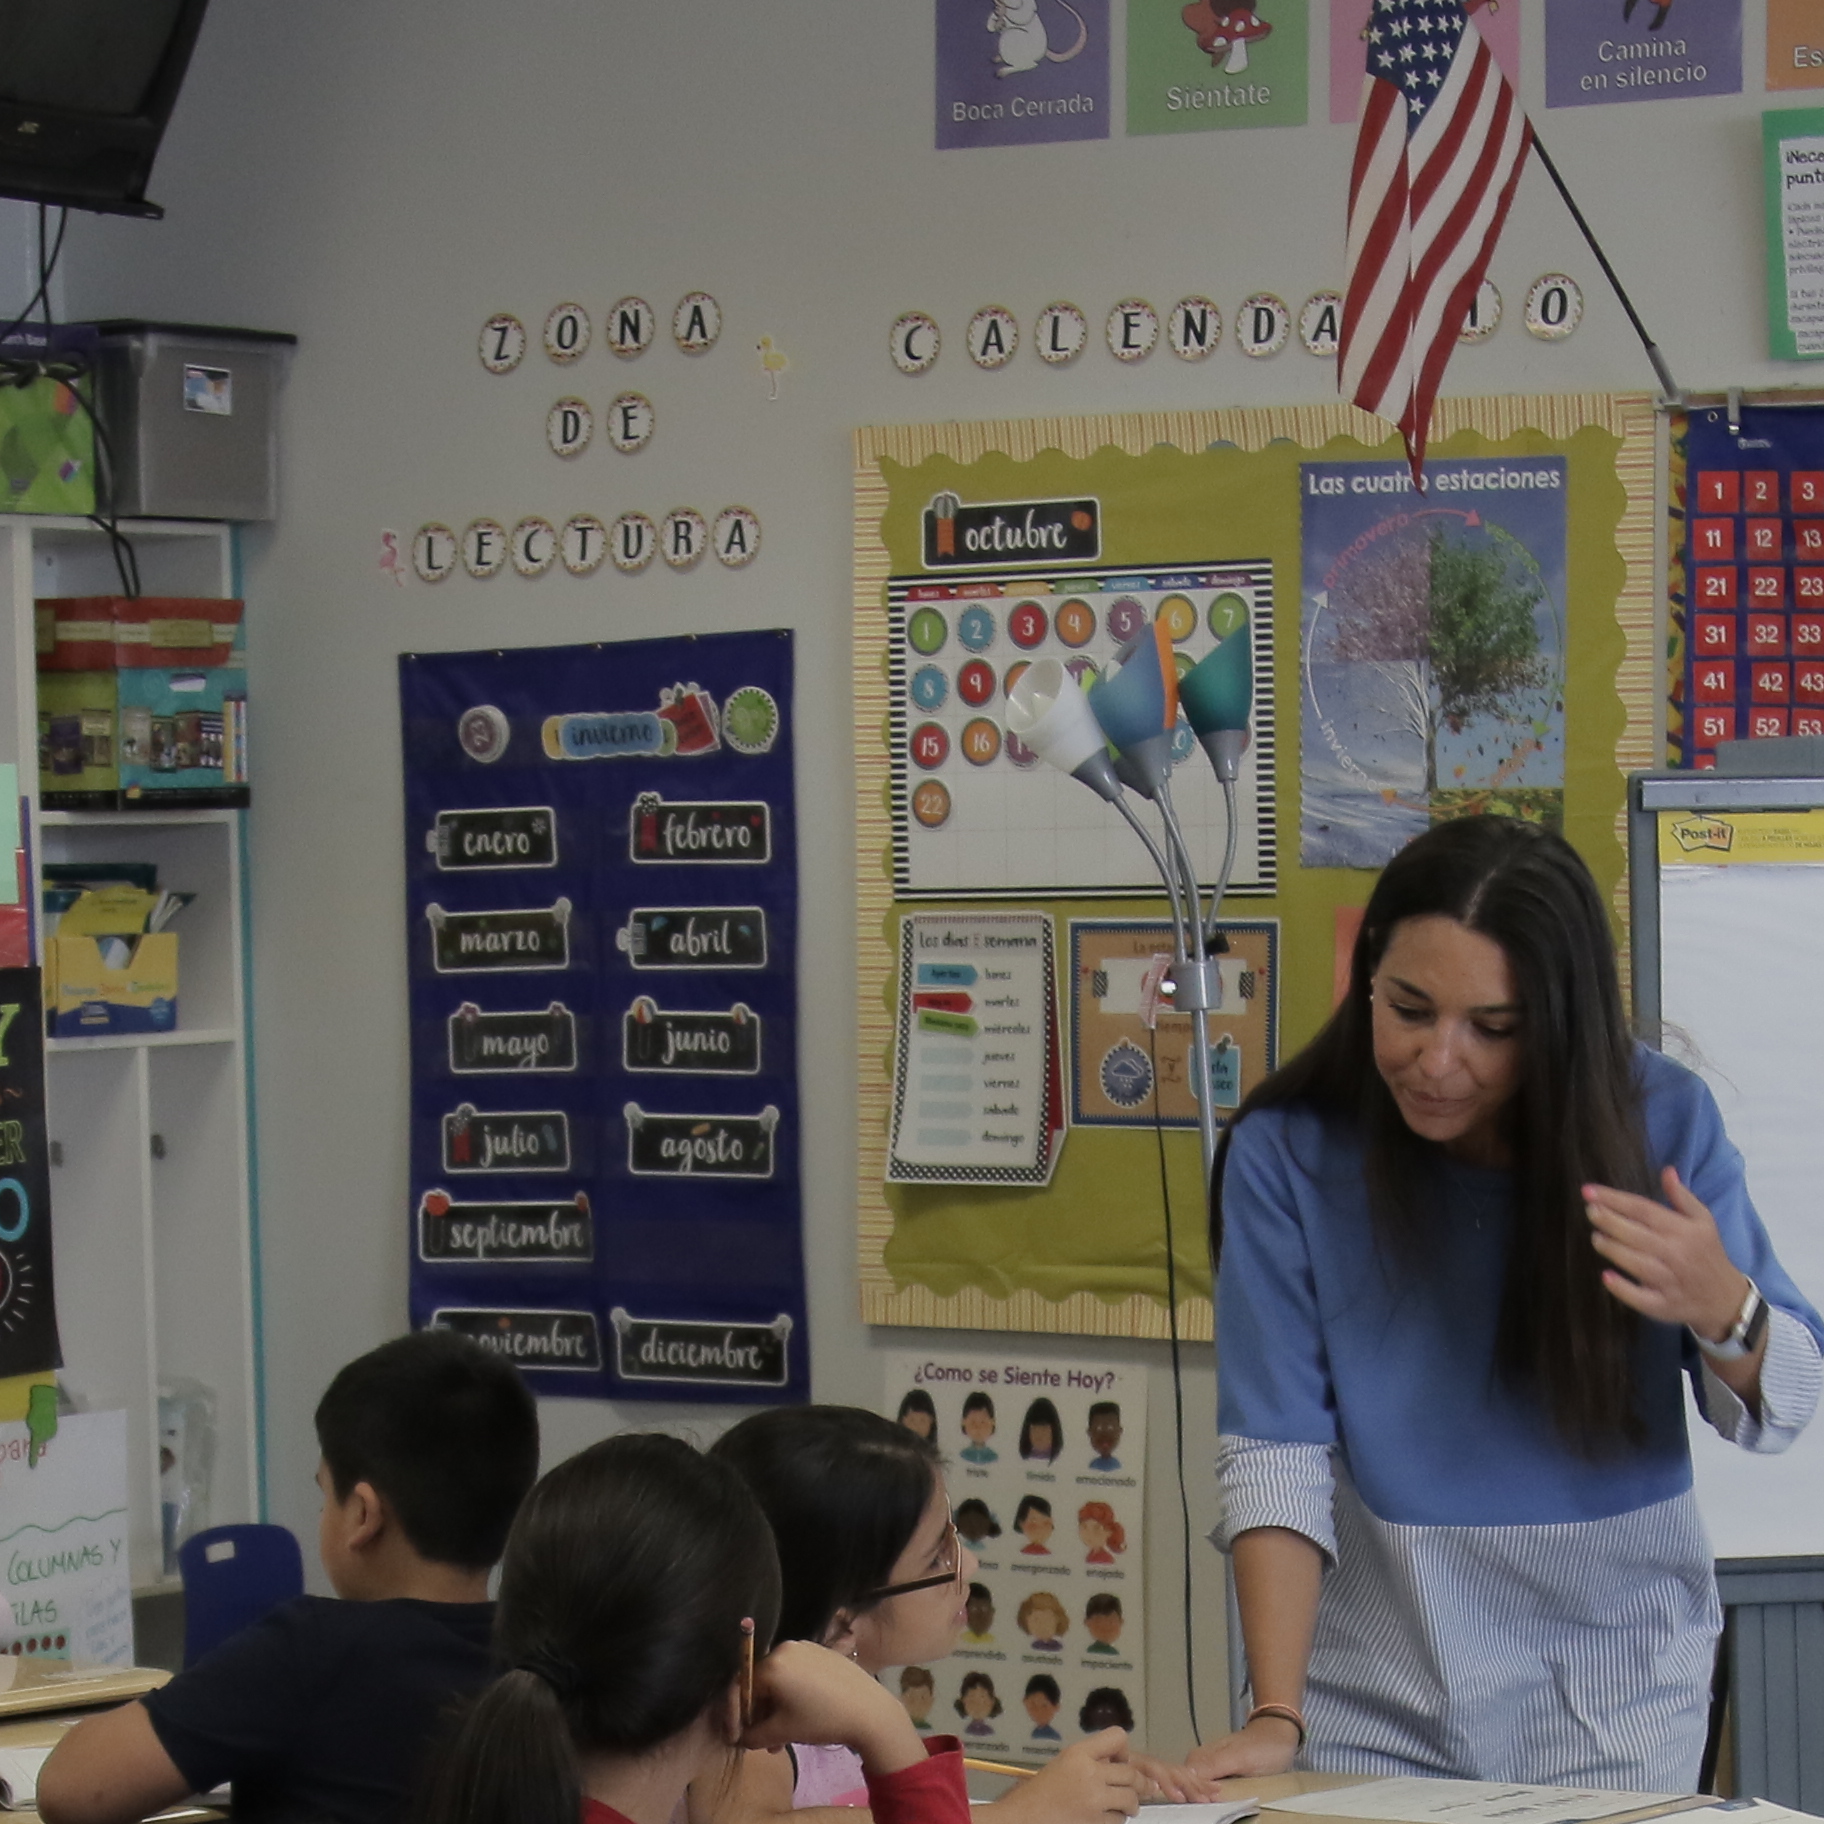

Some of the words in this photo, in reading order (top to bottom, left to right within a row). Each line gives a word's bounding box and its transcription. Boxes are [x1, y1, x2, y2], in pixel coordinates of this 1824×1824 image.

[1598, 37, 1688, 63] Camina
[1579, 73, 1608, 92] en
[1614, 62, 1708, 87] silencio
[952, 100, 1004, 122] Boca
[1011, 93, 1094, 119] Cerrada
[1166, 83, 1272, 112] Siéntate
[493, 304, 707, 362] ZONA
[562, 404, 639, 445] DE
[1308, 473, 1344, 495] Las
[1436, 467, 1561, 491] estaciones
[426, 518, 747, 571] LECTURA
[965, 508, 1067, 553] octubre
[1706, 530, 1720, 547] 11
[1755, 529, 1772, 547] 12
[1803, 530, 1821, 548] 13
[463, 828, 531, 857] enero
[663, 811, 752, 856] febrero
[1680, 828, 1727, 841] Post-it
[460, 928, 541, 952] marzo
[669, 918, 732, 956] abril
[482, 1032, 550, 1068] mayo
[662, 1022, 731, 1065] junio
[480, 1126, 540, 1169] julio
[660, 1129, 743, 1173] agosto
[449, 1209, 584, 1259] septiembre
[640, 1328, 763, 1370] diciembre
[914, 1363, 973, 1384] ¿Como
[979, 1369, 998, 1384] se
[1004, 1366, 1060, 1387] Siente
[1067, 1370, 1115, 1393] Hoy?
[7, 1544, 102, 1586] COLUMNAS
